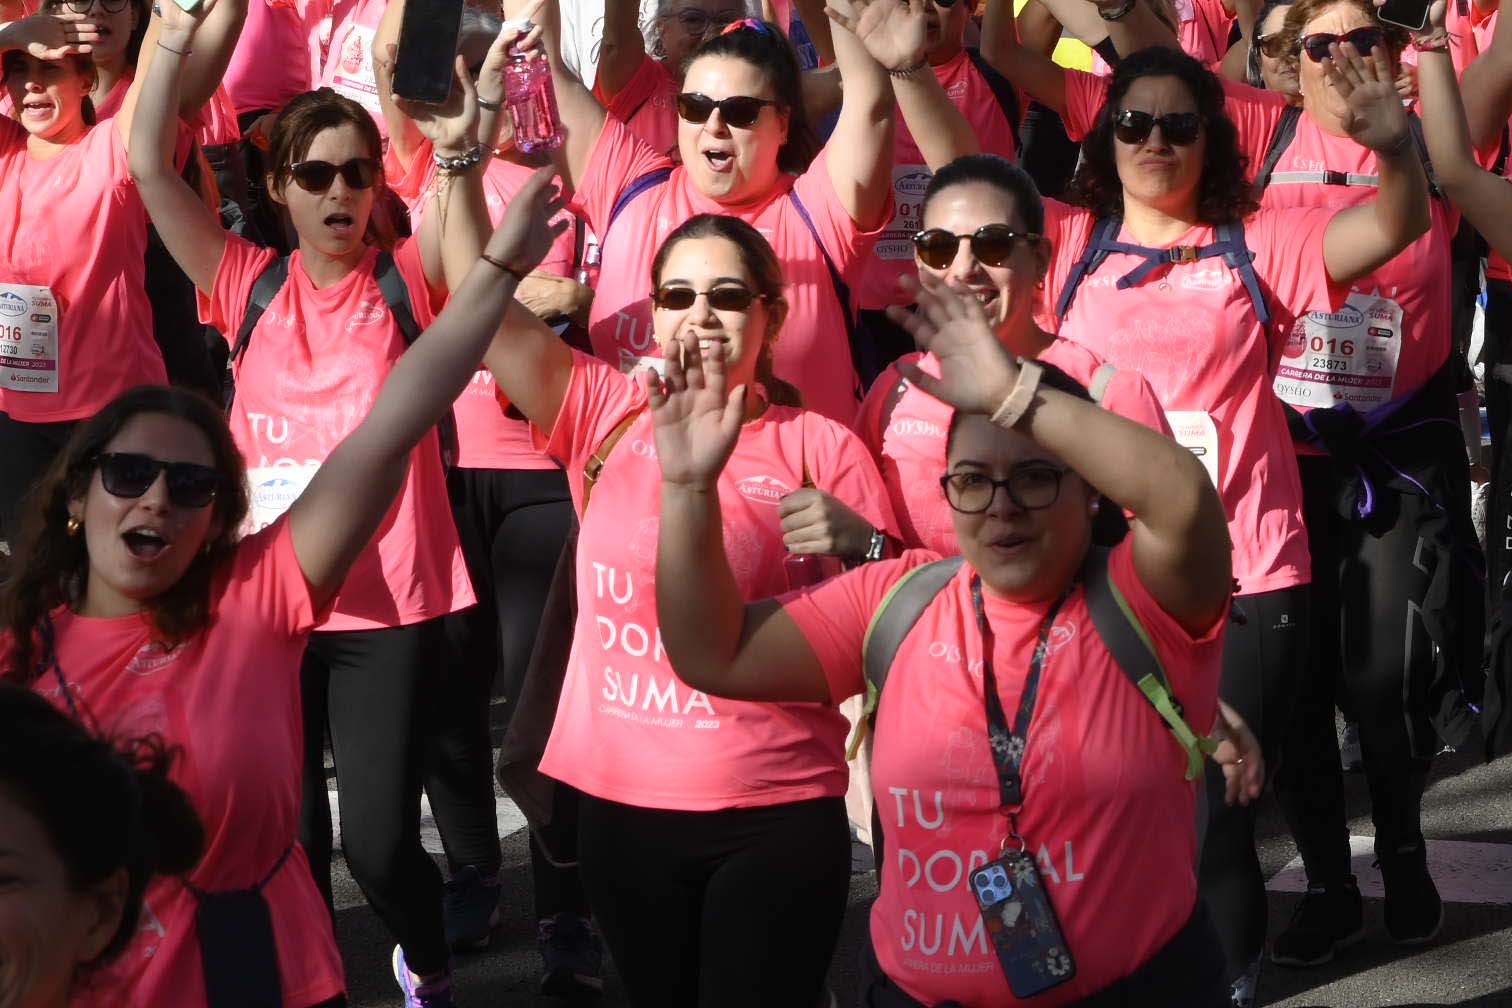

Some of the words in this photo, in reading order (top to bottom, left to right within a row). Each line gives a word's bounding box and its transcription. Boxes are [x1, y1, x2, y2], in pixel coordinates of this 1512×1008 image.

[612, 311, 651, 349] TU
[1310, 336, 1355, 356] 016
[16, 374, 49, 384] Santander
[1280, 368, 1313, 379] CARRERA
[1312, 358, 1347, 371] 23873
[247, 413, 288, 442] TU
[593, 561, 633, 604] TU
[601, 666, 716, 716] SUMA
[695, 718, 720, 730] 2023
[889, 787, 944, 829] TU
[900, 908, 993, 957] SUM
